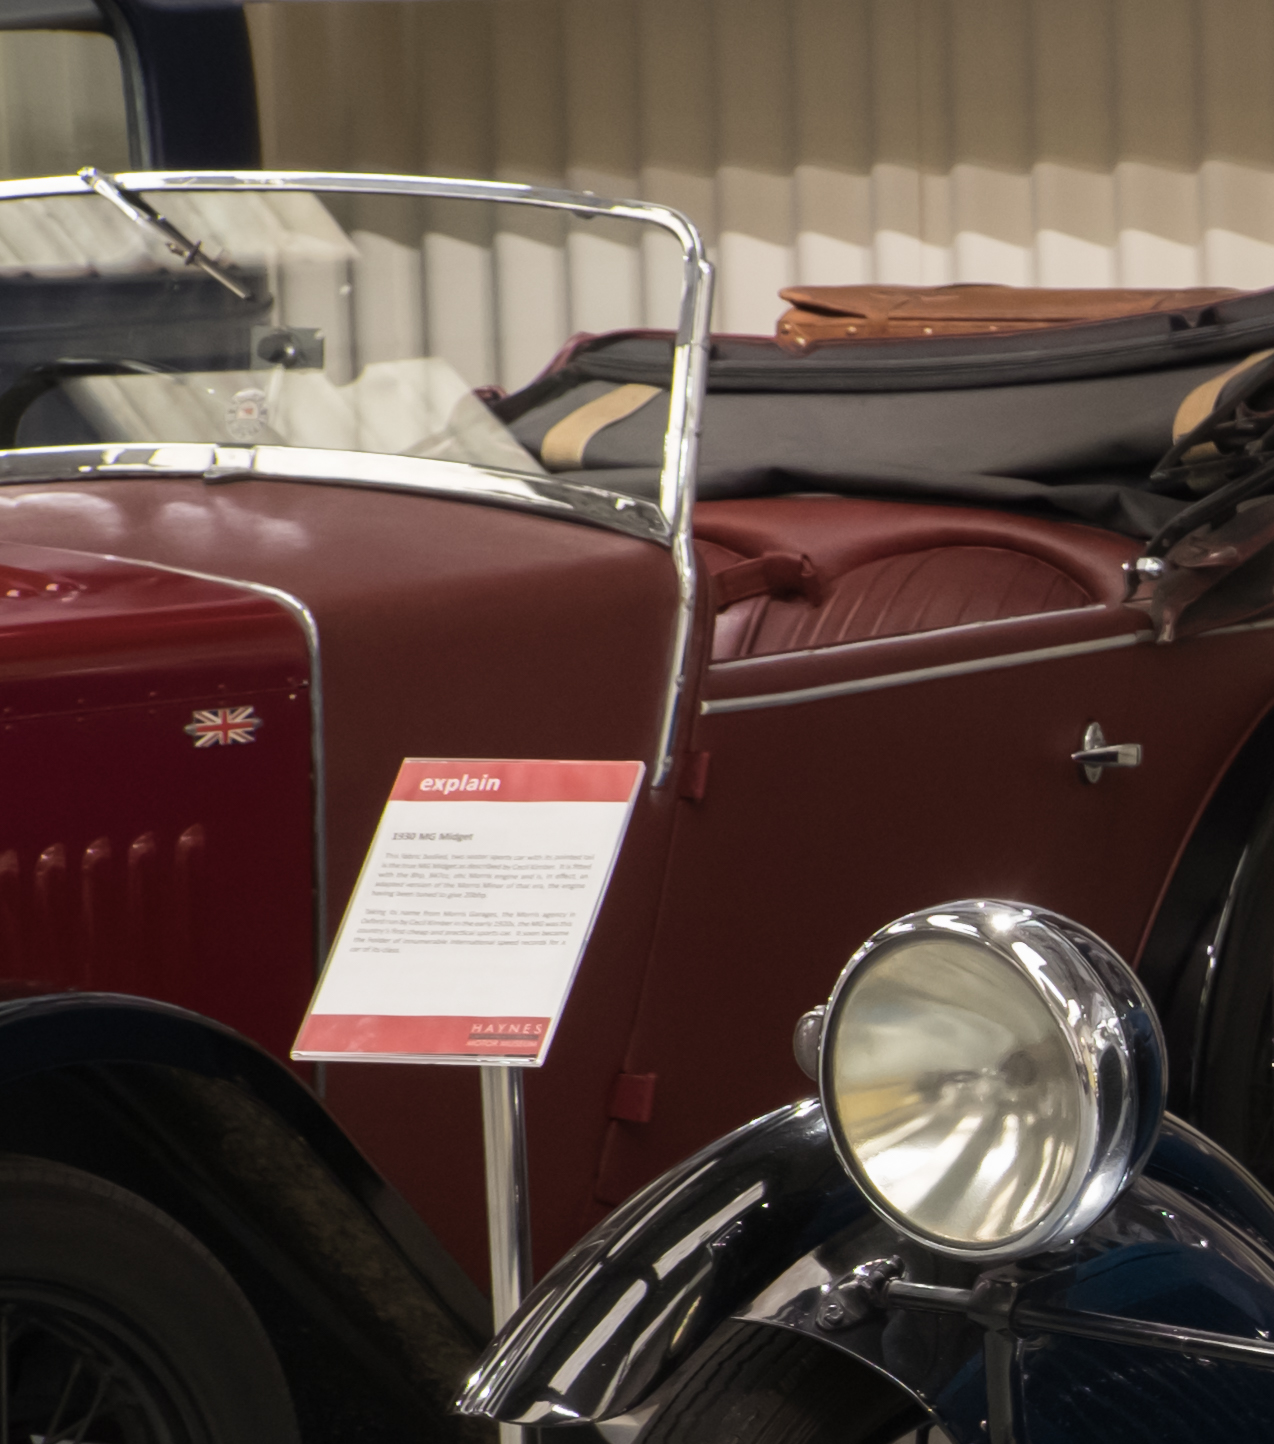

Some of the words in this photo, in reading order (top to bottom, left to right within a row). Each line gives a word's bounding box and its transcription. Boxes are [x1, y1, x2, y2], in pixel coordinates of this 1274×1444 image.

[420, 774, 501, 795] explain
[418, 833, 437, 841] MG
[439, 833, 474, 842] Midget
[471, 1023, 543, 1034] HAYNES
